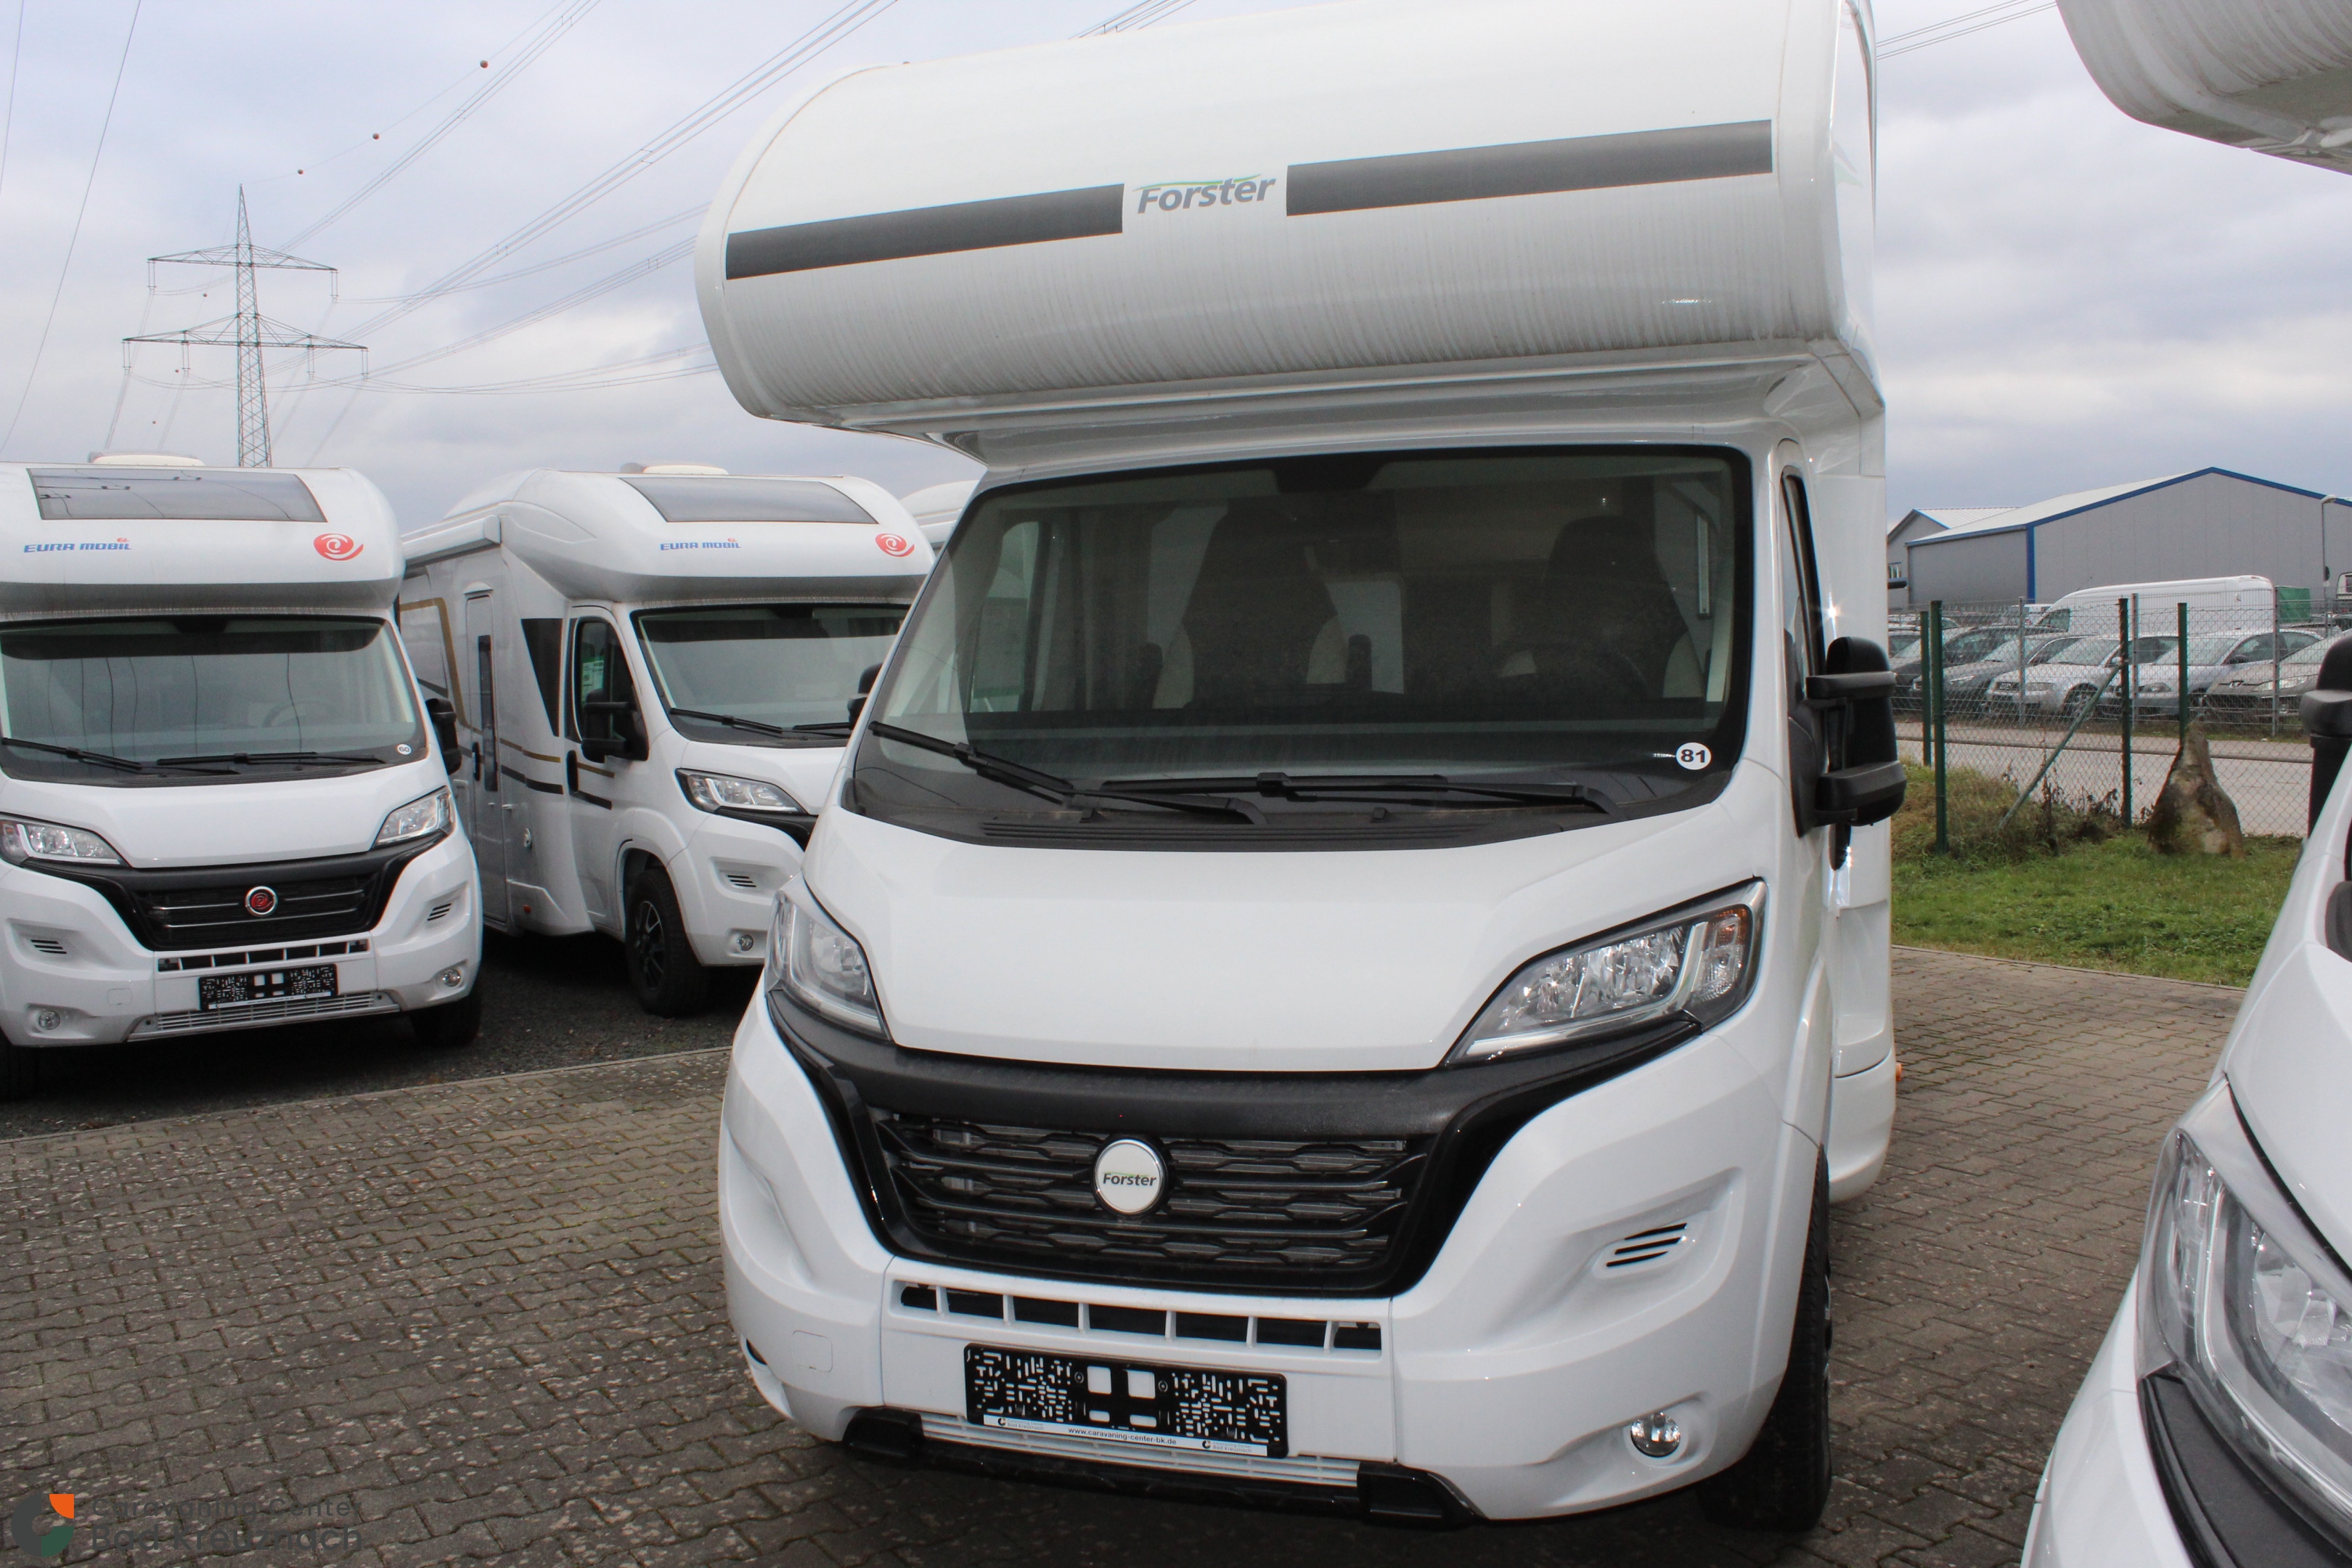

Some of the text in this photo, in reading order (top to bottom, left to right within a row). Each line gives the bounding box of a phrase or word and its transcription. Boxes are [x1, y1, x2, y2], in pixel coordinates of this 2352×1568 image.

[1138, 177, 1276, 214] Forster
[24, 543, 75, 552] EURA
[1681, 749, 1706, 763] 81
[1103, 1173, 1156, 1185] Forster
[1068, 1427, 1177, 1445] www.caravaning-center-bk.de
